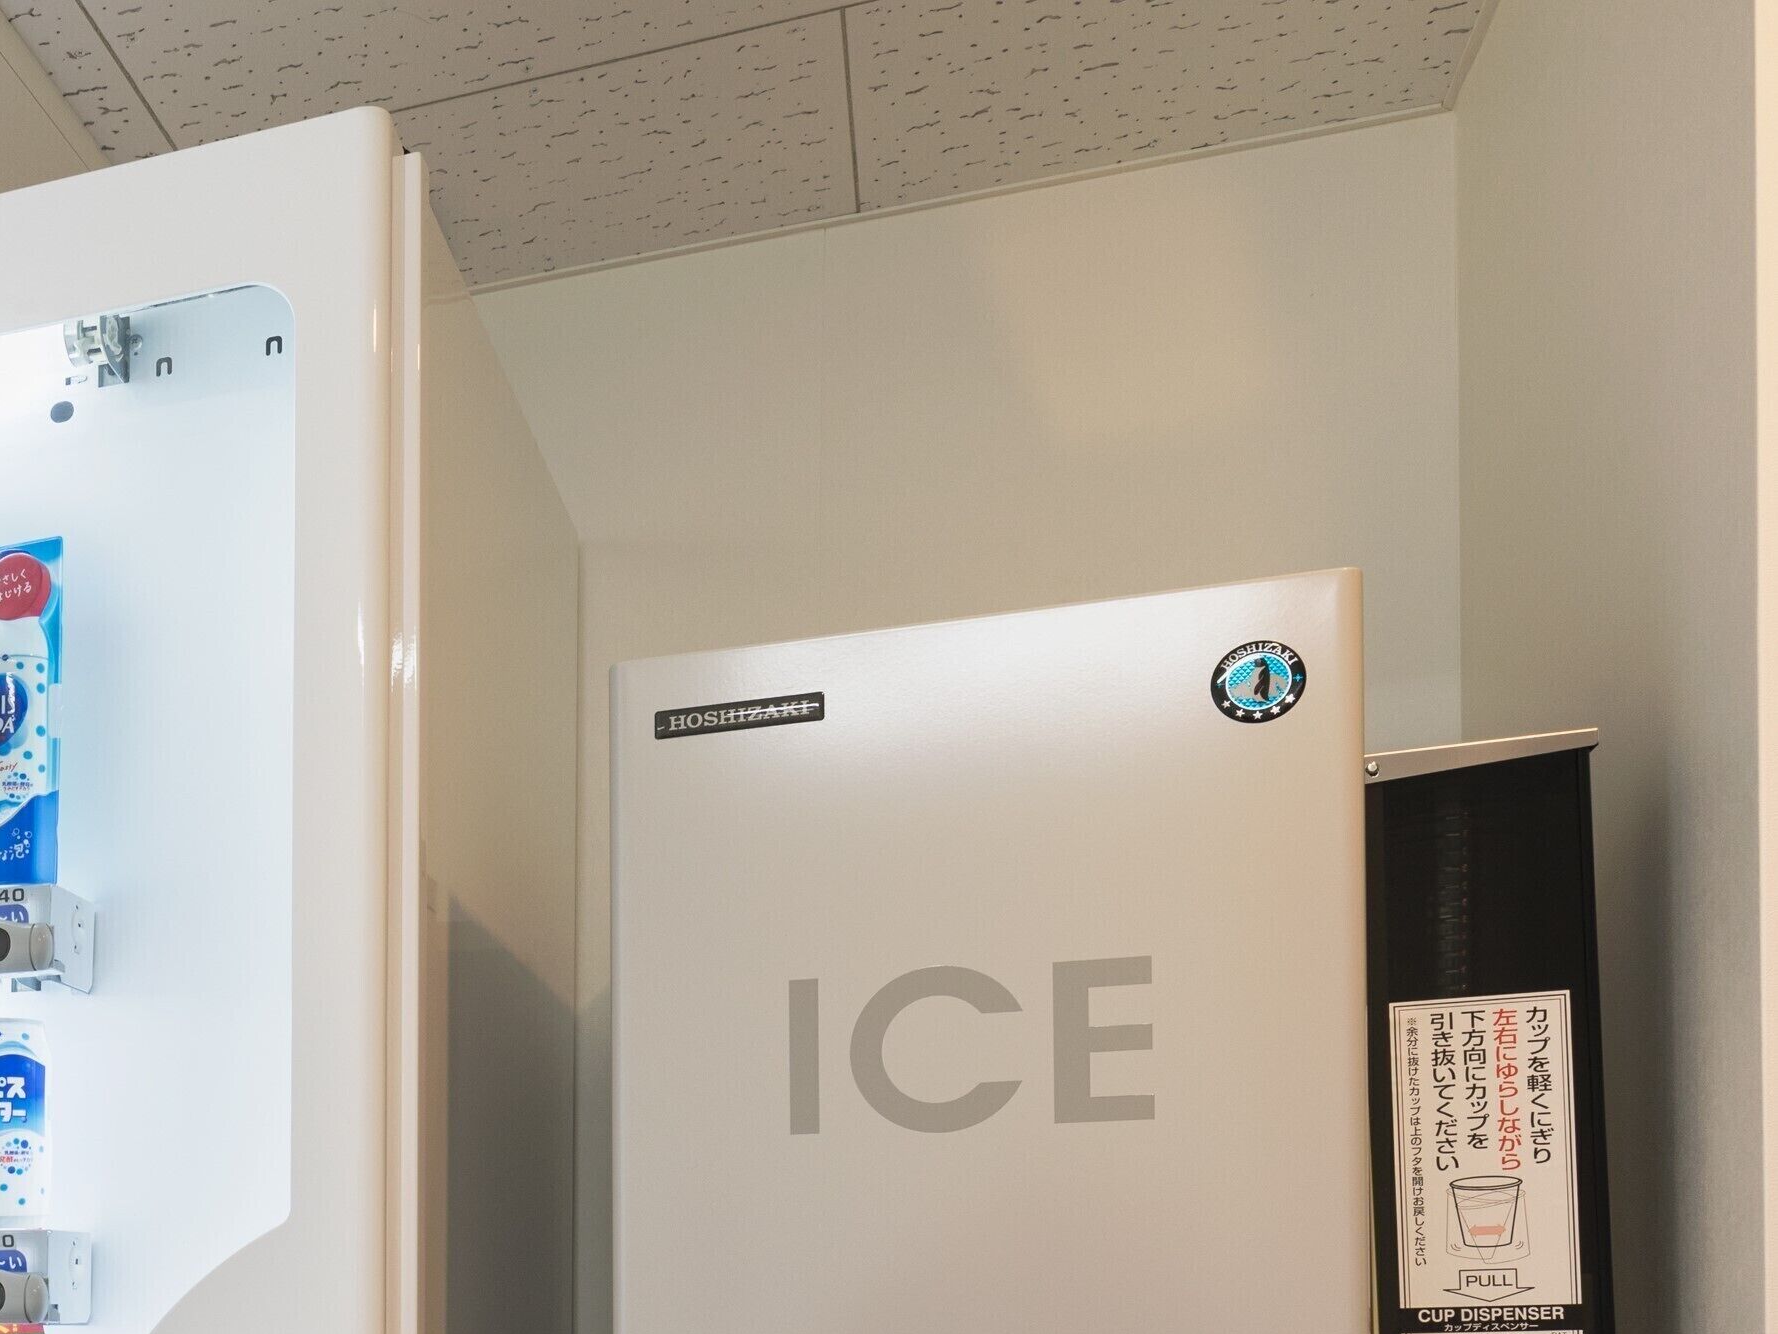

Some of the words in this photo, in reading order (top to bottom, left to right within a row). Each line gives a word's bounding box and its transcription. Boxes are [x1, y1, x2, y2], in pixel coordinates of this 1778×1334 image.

[668, 700, 810, 732] HOSHIZAKI
[788, 955, 1155, 1134] ICE
[1430, 1011, 1459, 1171] 引き抜いてください
[1461, 1009, 1488, 1150] 下方向にカップを
[1492, 1008, 1521, 1171] 左右にゆらしながら
[1525, 1006, 1553, 1165] カップを軽くにぎり
[1418, 1309, 1455, 1323] CUP
[1461, 1307, 1565, 1322] DISPENSER
[1444, 1323, 1539, 1332] カップディスペンサー
[1466, 1273, 1513, 1288] PULL
